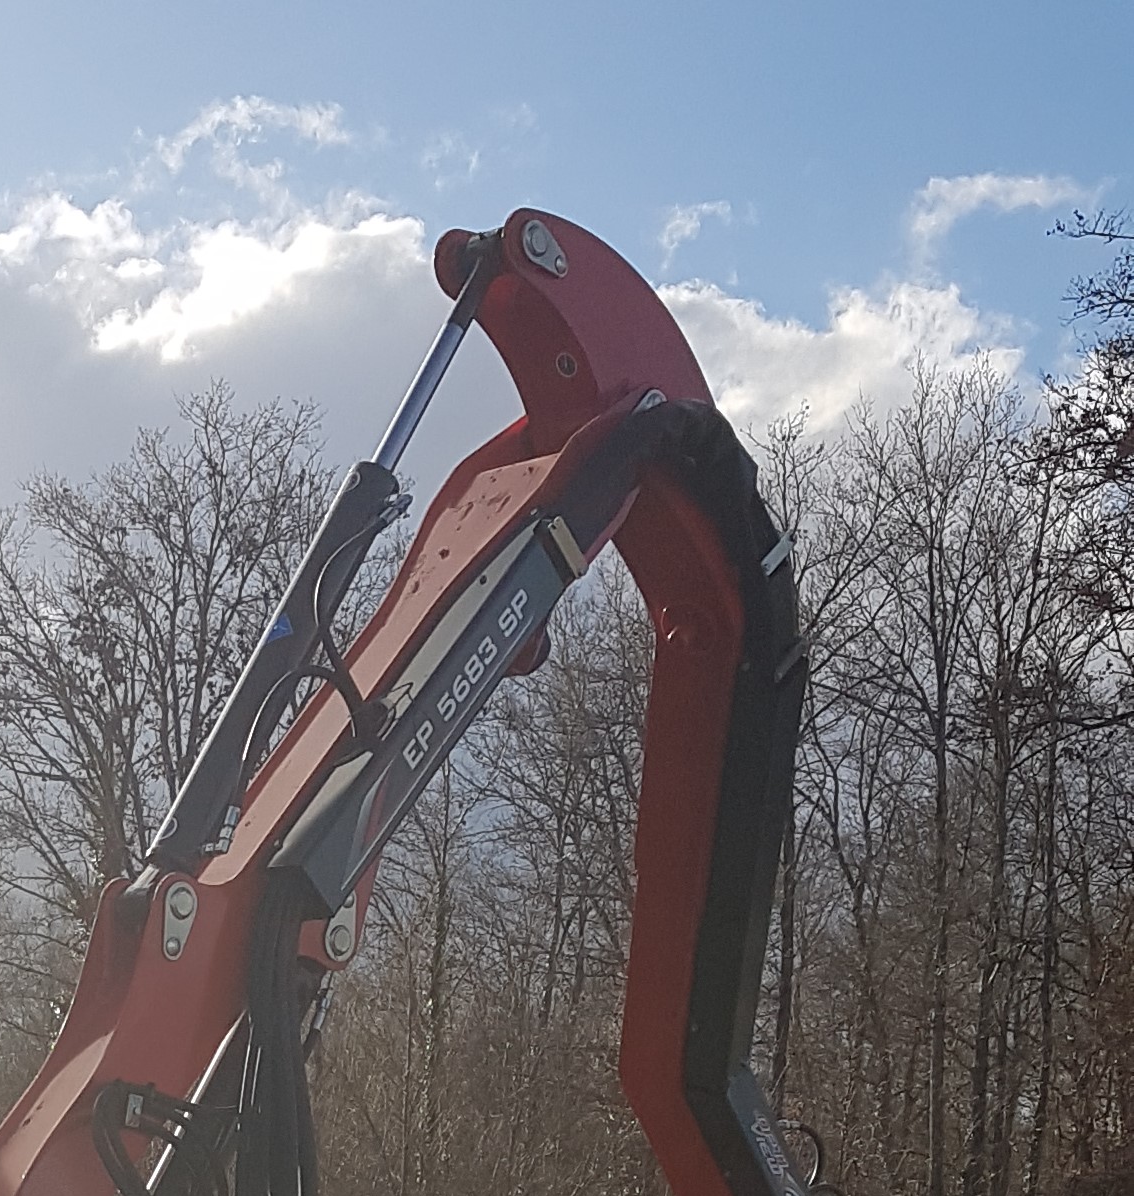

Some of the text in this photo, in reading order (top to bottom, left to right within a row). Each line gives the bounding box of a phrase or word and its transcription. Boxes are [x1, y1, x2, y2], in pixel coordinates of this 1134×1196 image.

[402, 588, 529, 770] EP 5683 SP
